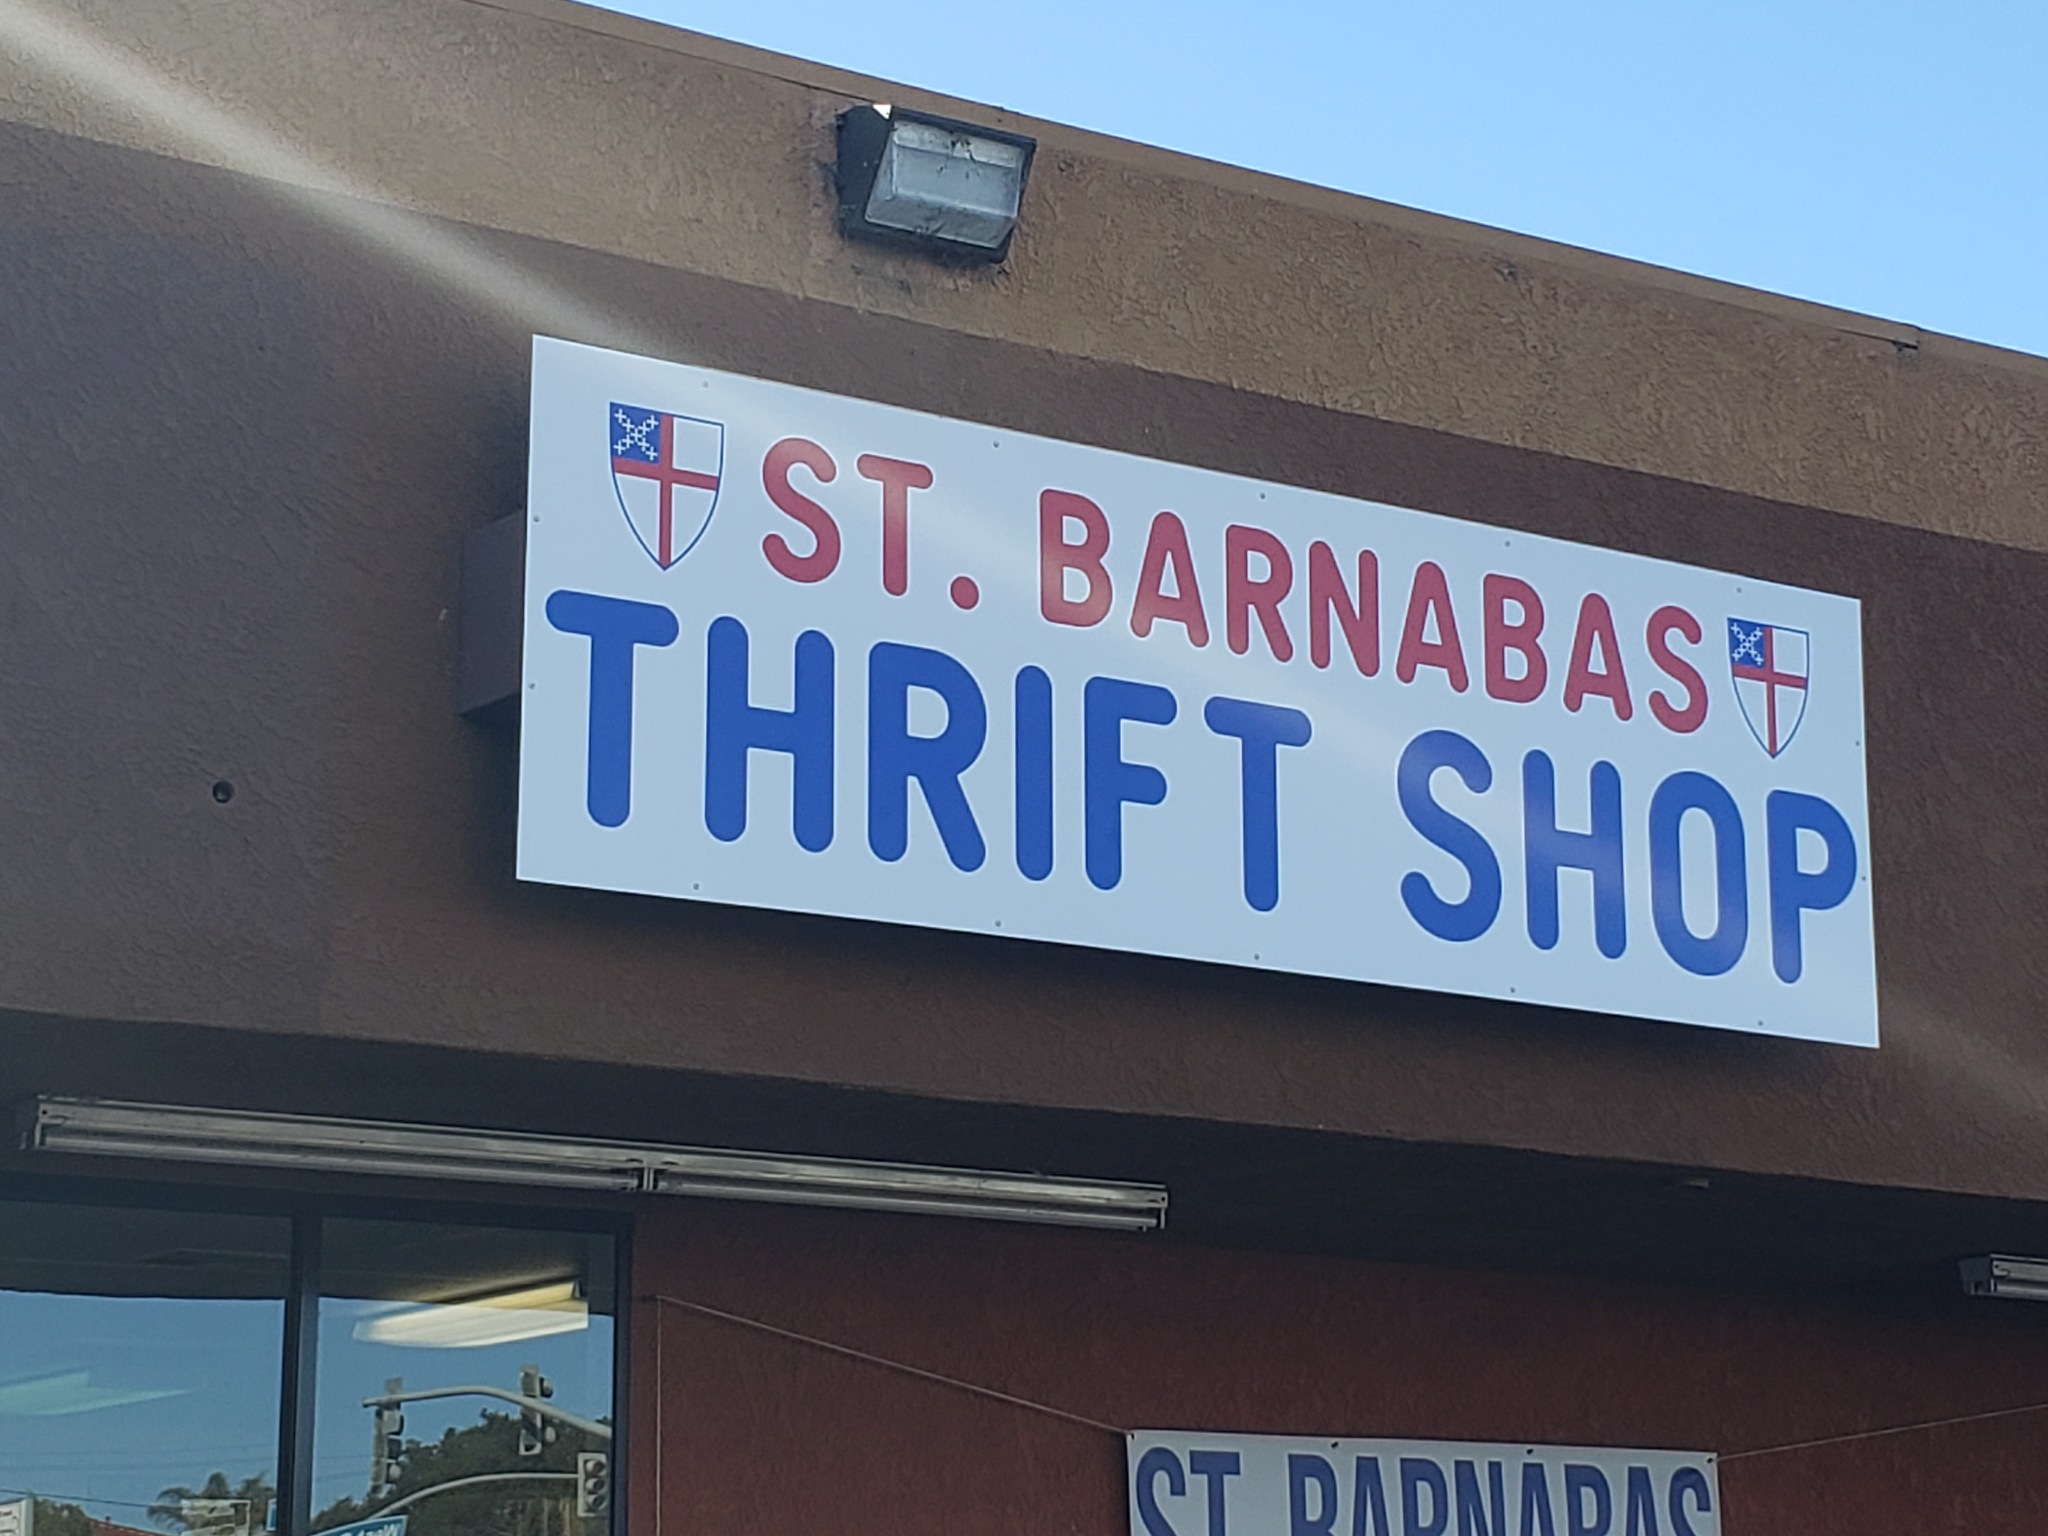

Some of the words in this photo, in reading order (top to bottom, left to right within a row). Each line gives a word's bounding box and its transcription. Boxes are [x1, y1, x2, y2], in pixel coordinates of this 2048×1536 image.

[762, 437, 979, 609] ST.
[1040, 489, 1710, 734] BARNABAS
[544, 588, 1314, 914] THRIFT
[1396, 728, 1859, 986] SHOP
